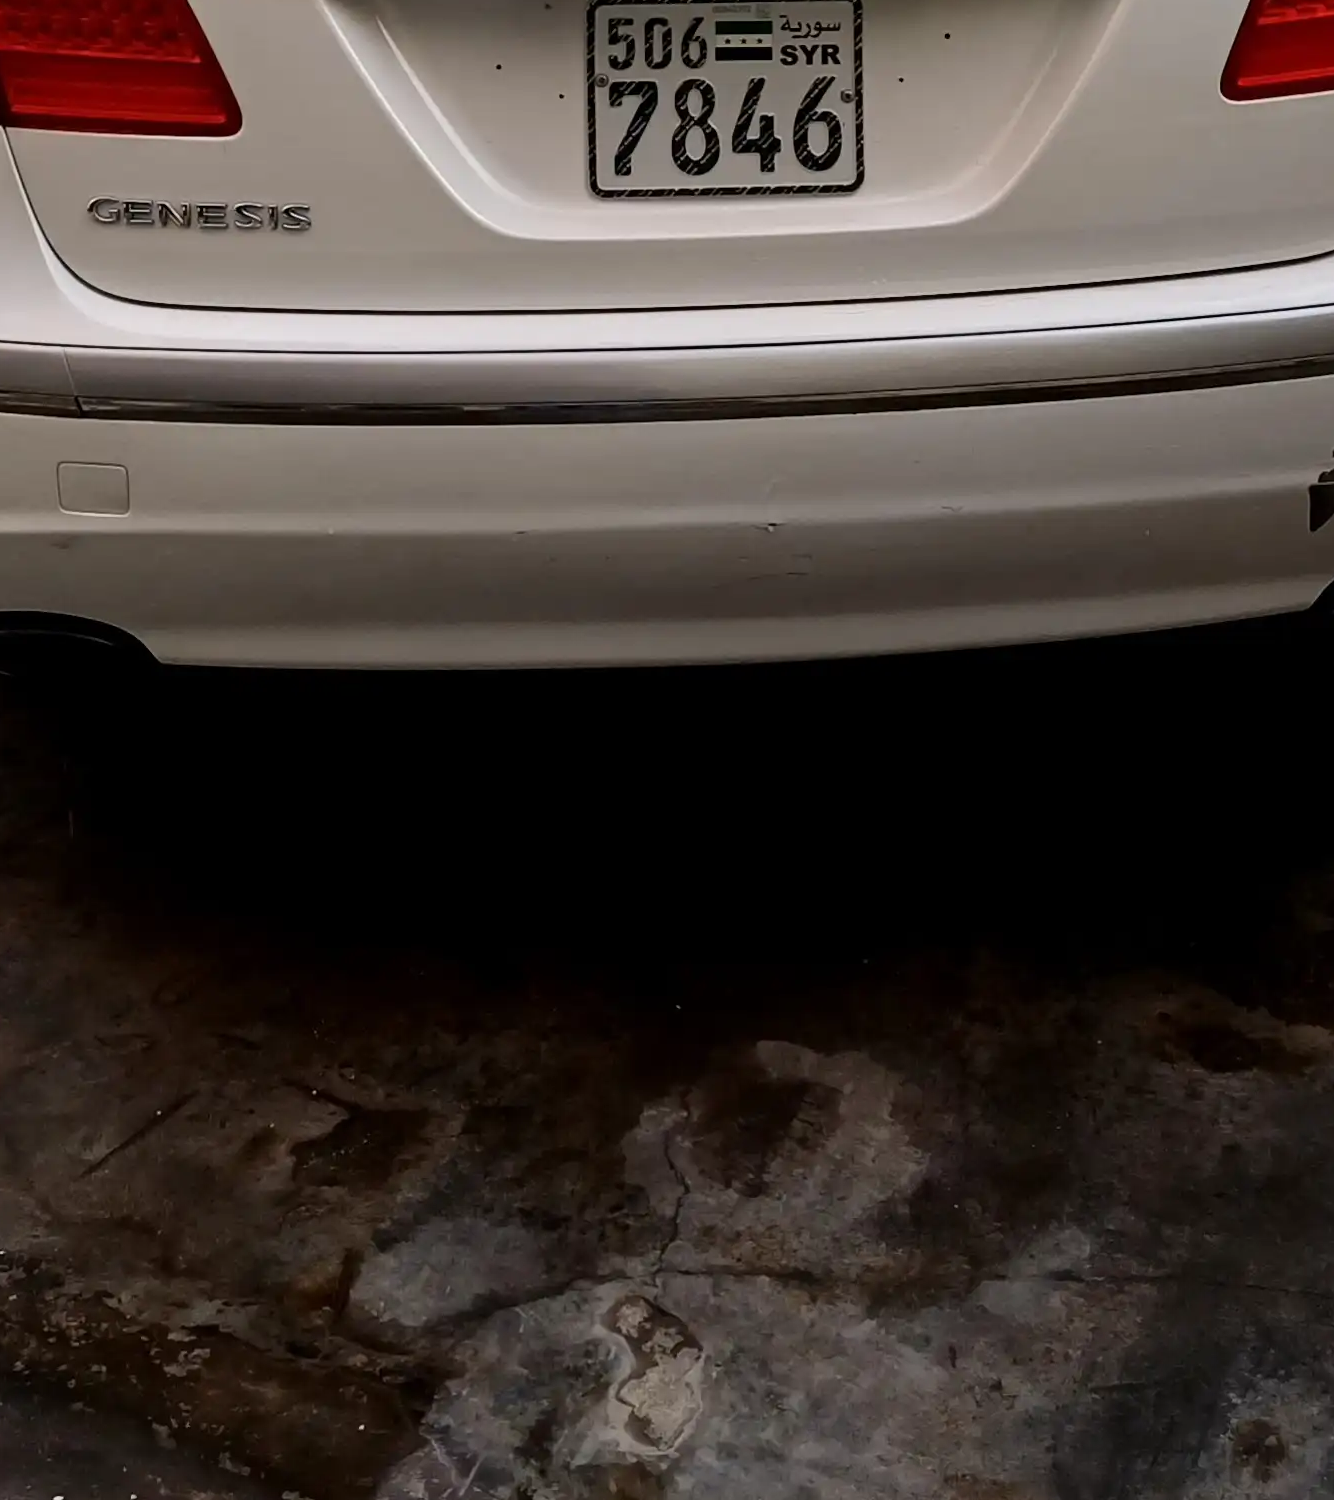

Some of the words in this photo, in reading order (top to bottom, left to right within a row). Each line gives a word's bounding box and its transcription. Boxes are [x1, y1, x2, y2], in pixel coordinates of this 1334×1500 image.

[608, 16, 708, 71] 506
[779, 14, 842, 39] سورية
[779, 44, 841, 67] SYR
[608, 75, 844, 177] 7846
[87, 195, 313, 231] GENESIS
